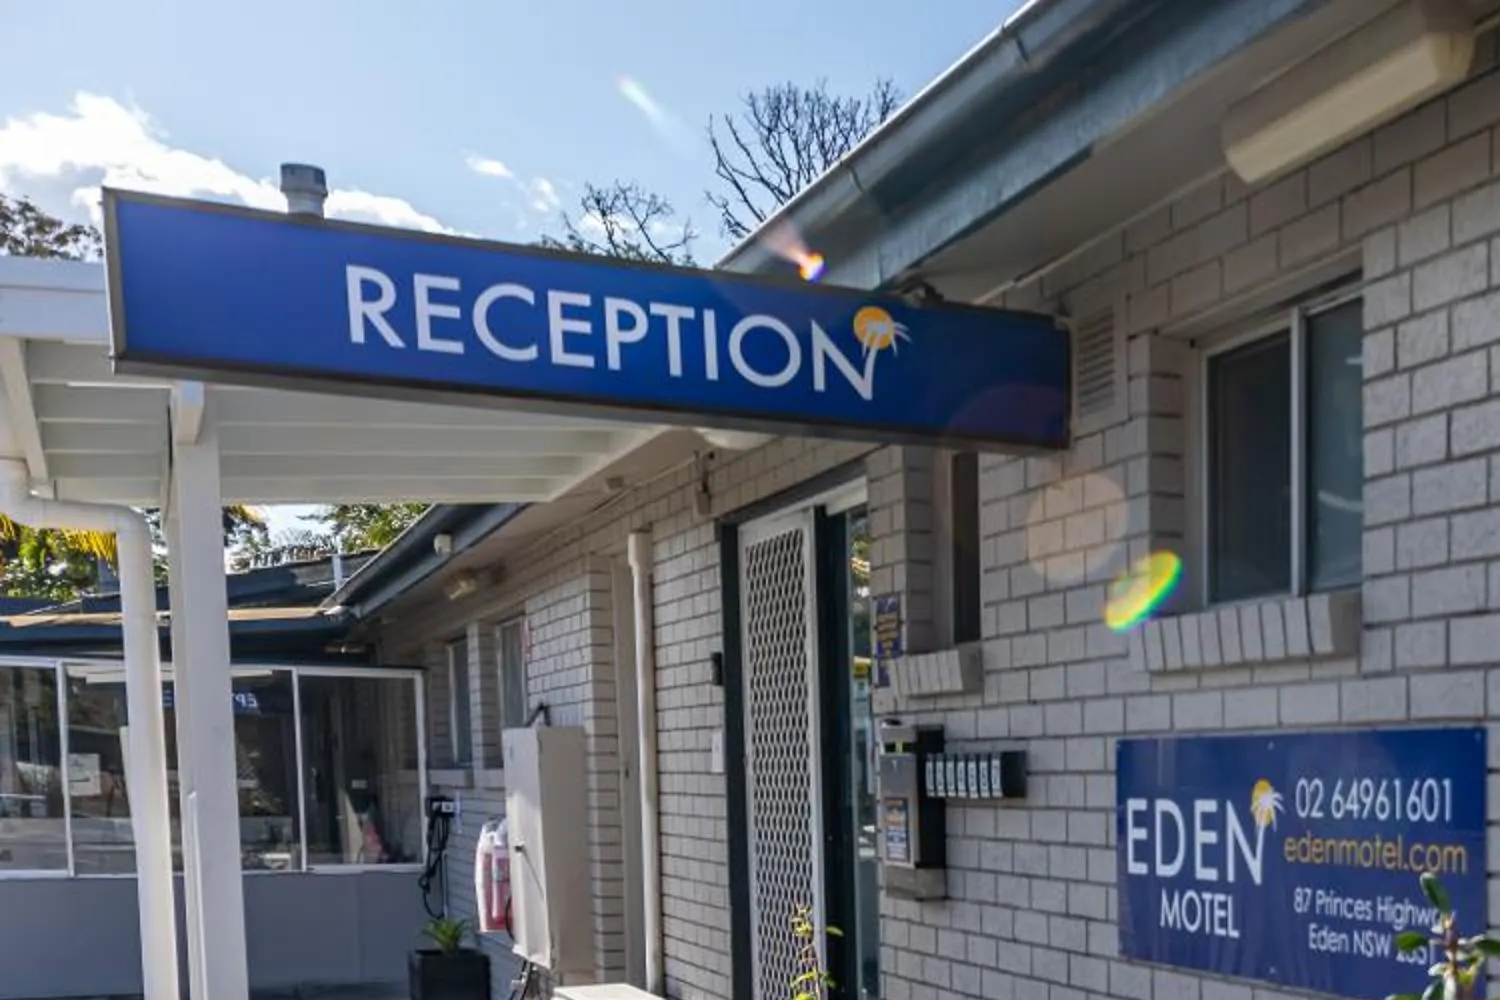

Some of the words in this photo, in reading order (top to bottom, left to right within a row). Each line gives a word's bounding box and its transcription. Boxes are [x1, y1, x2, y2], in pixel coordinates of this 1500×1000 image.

[345, 265, 884, 400] RECEPTION
[1295, 777, 1325, 819] 02
[1127, 798, 1266, 886] EDEN
[1283, 831, 1468, 875] edenmotel.com
[1160, 887, 1240, 938] MOTEL
[1293, 887, 1312, 913] 87
[1315, 889, 1372, 921] Princes
[1308, 923, 1349, 953] Eden
[1353, 930, 1393, 959] NSW
